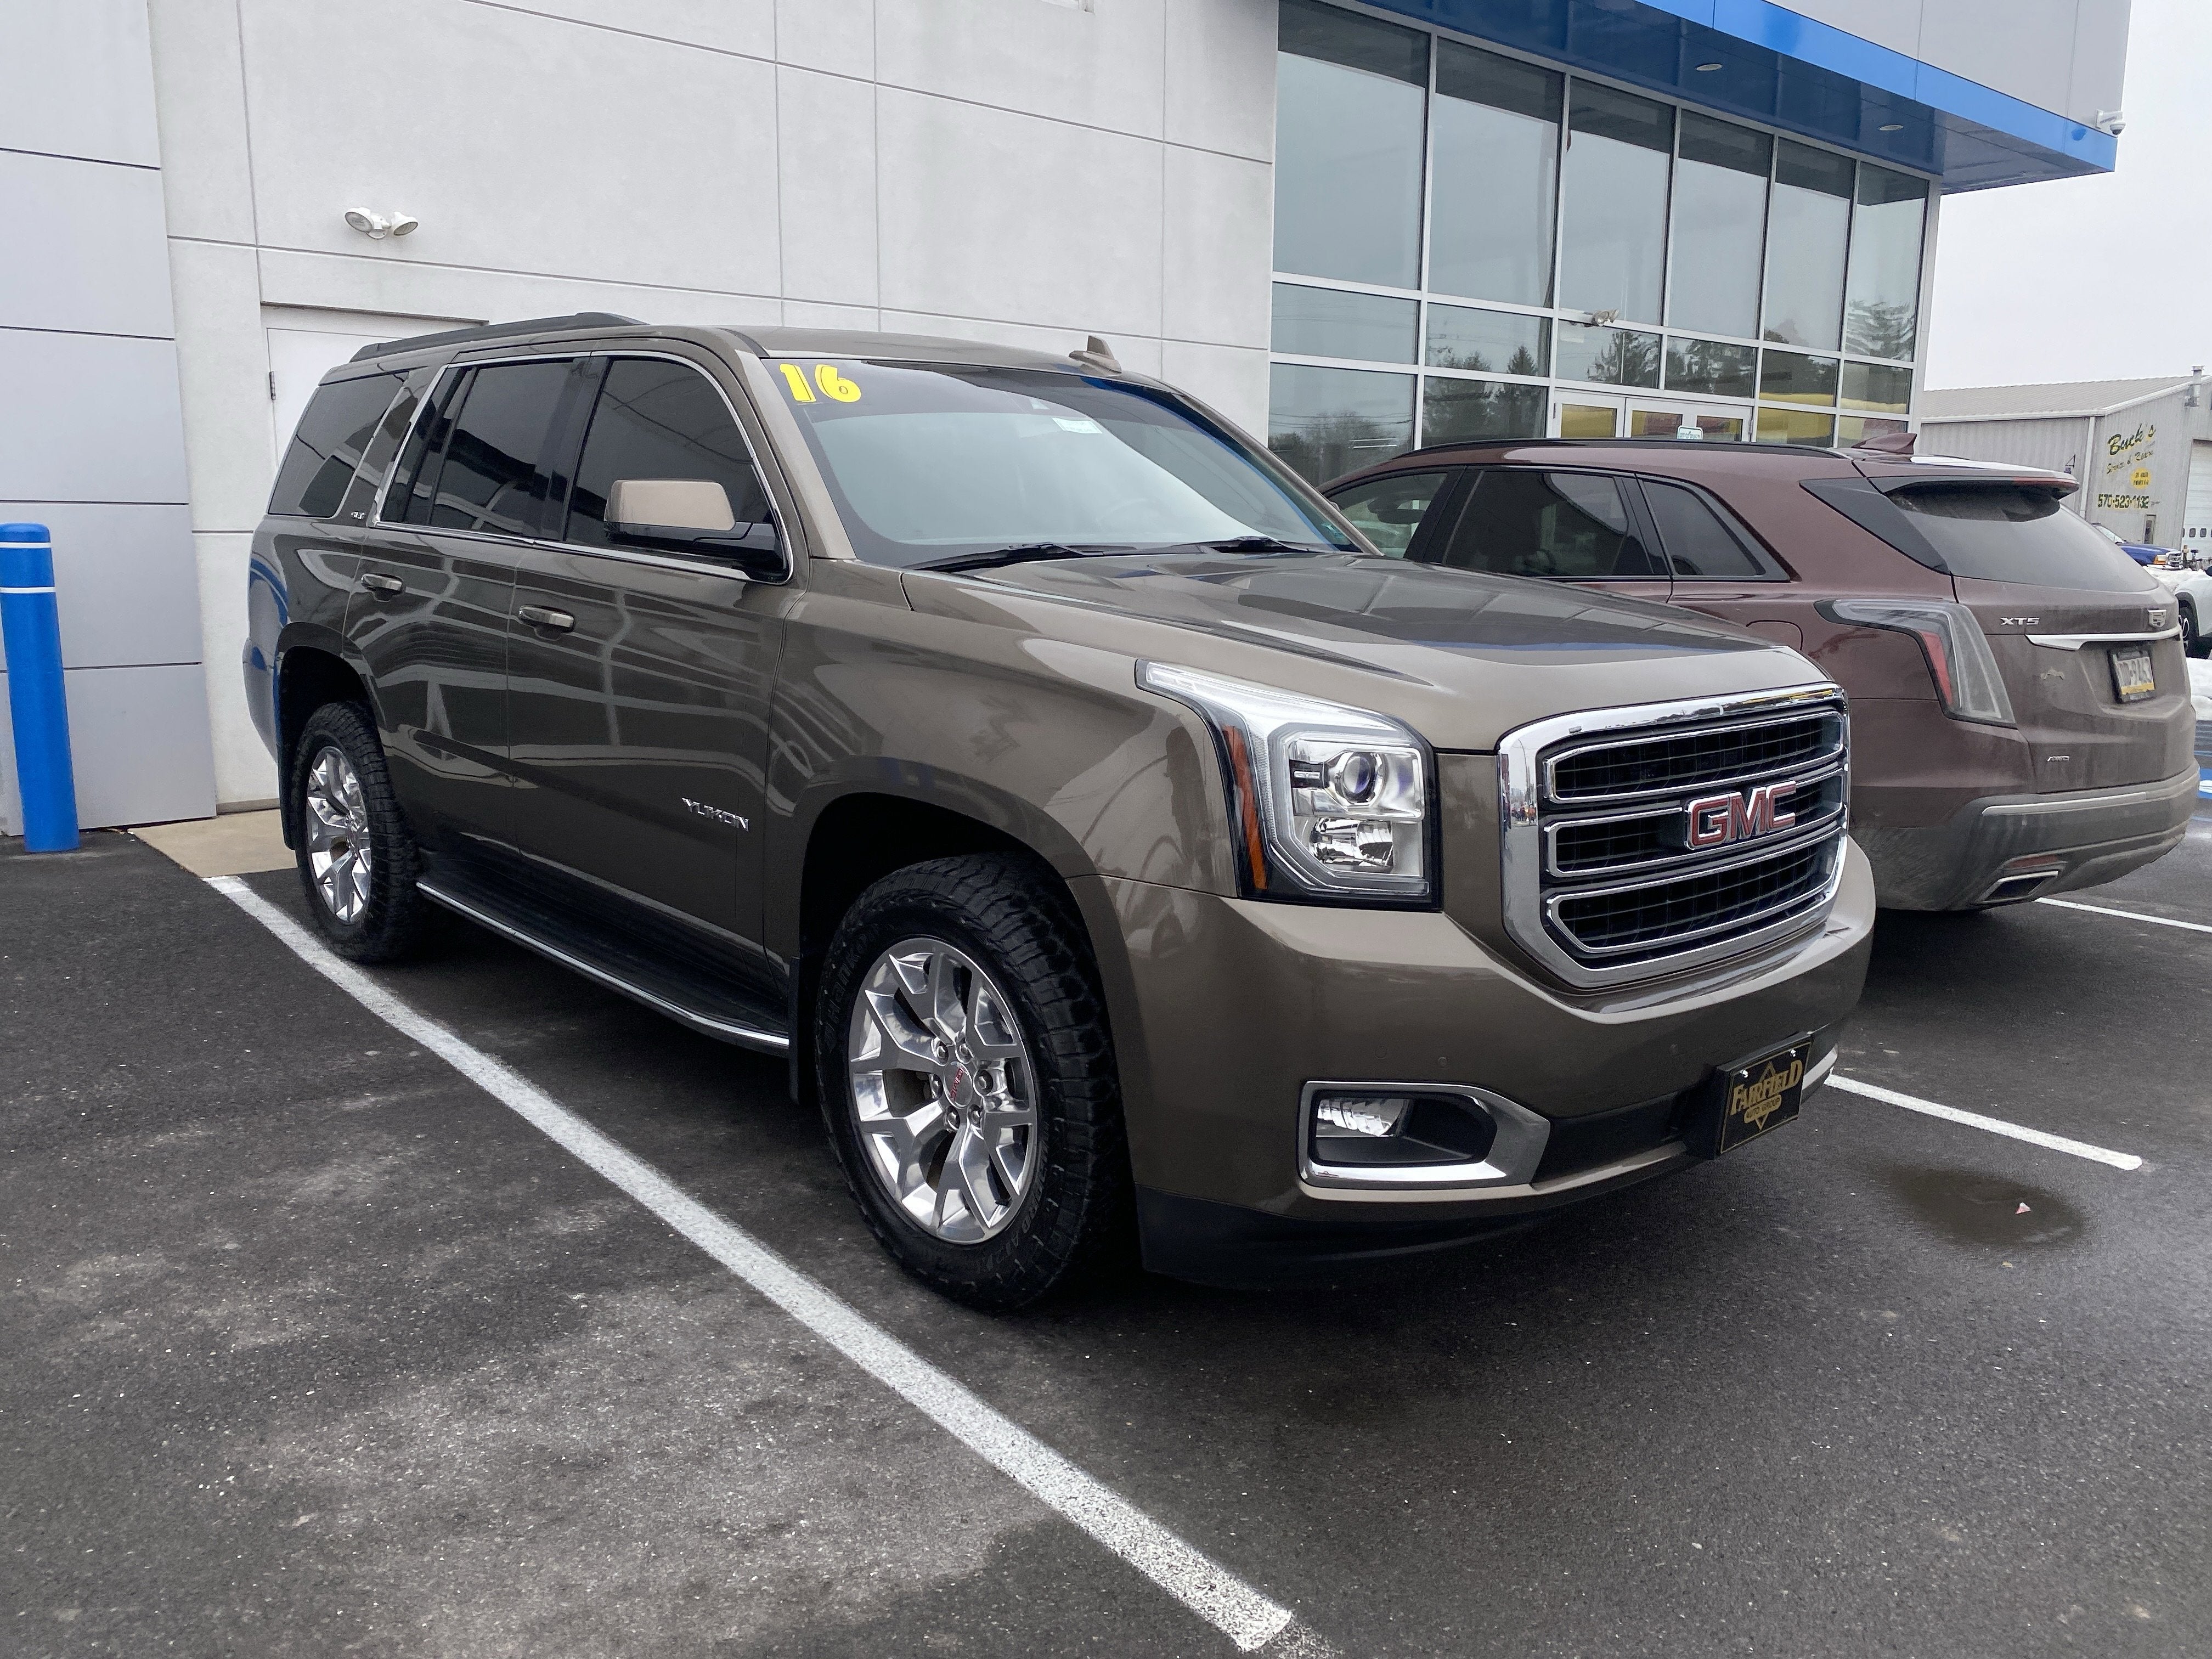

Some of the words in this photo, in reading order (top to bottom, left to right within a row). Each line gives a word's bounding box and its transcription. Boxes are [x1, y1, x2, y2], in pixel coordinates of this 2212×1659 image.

[780, 364, 861, 403] 16
[2107, 422, 2157, 455] Buck's
[2000, 617, 2040, 625] XT5
[681, 798, 749, 832] YUKON
[1685, 780, 1796, 850] GMC
[950, 1067, 965, 1102] GMC
[1730, 1060, 1803, 1116] FAIRFIELD
